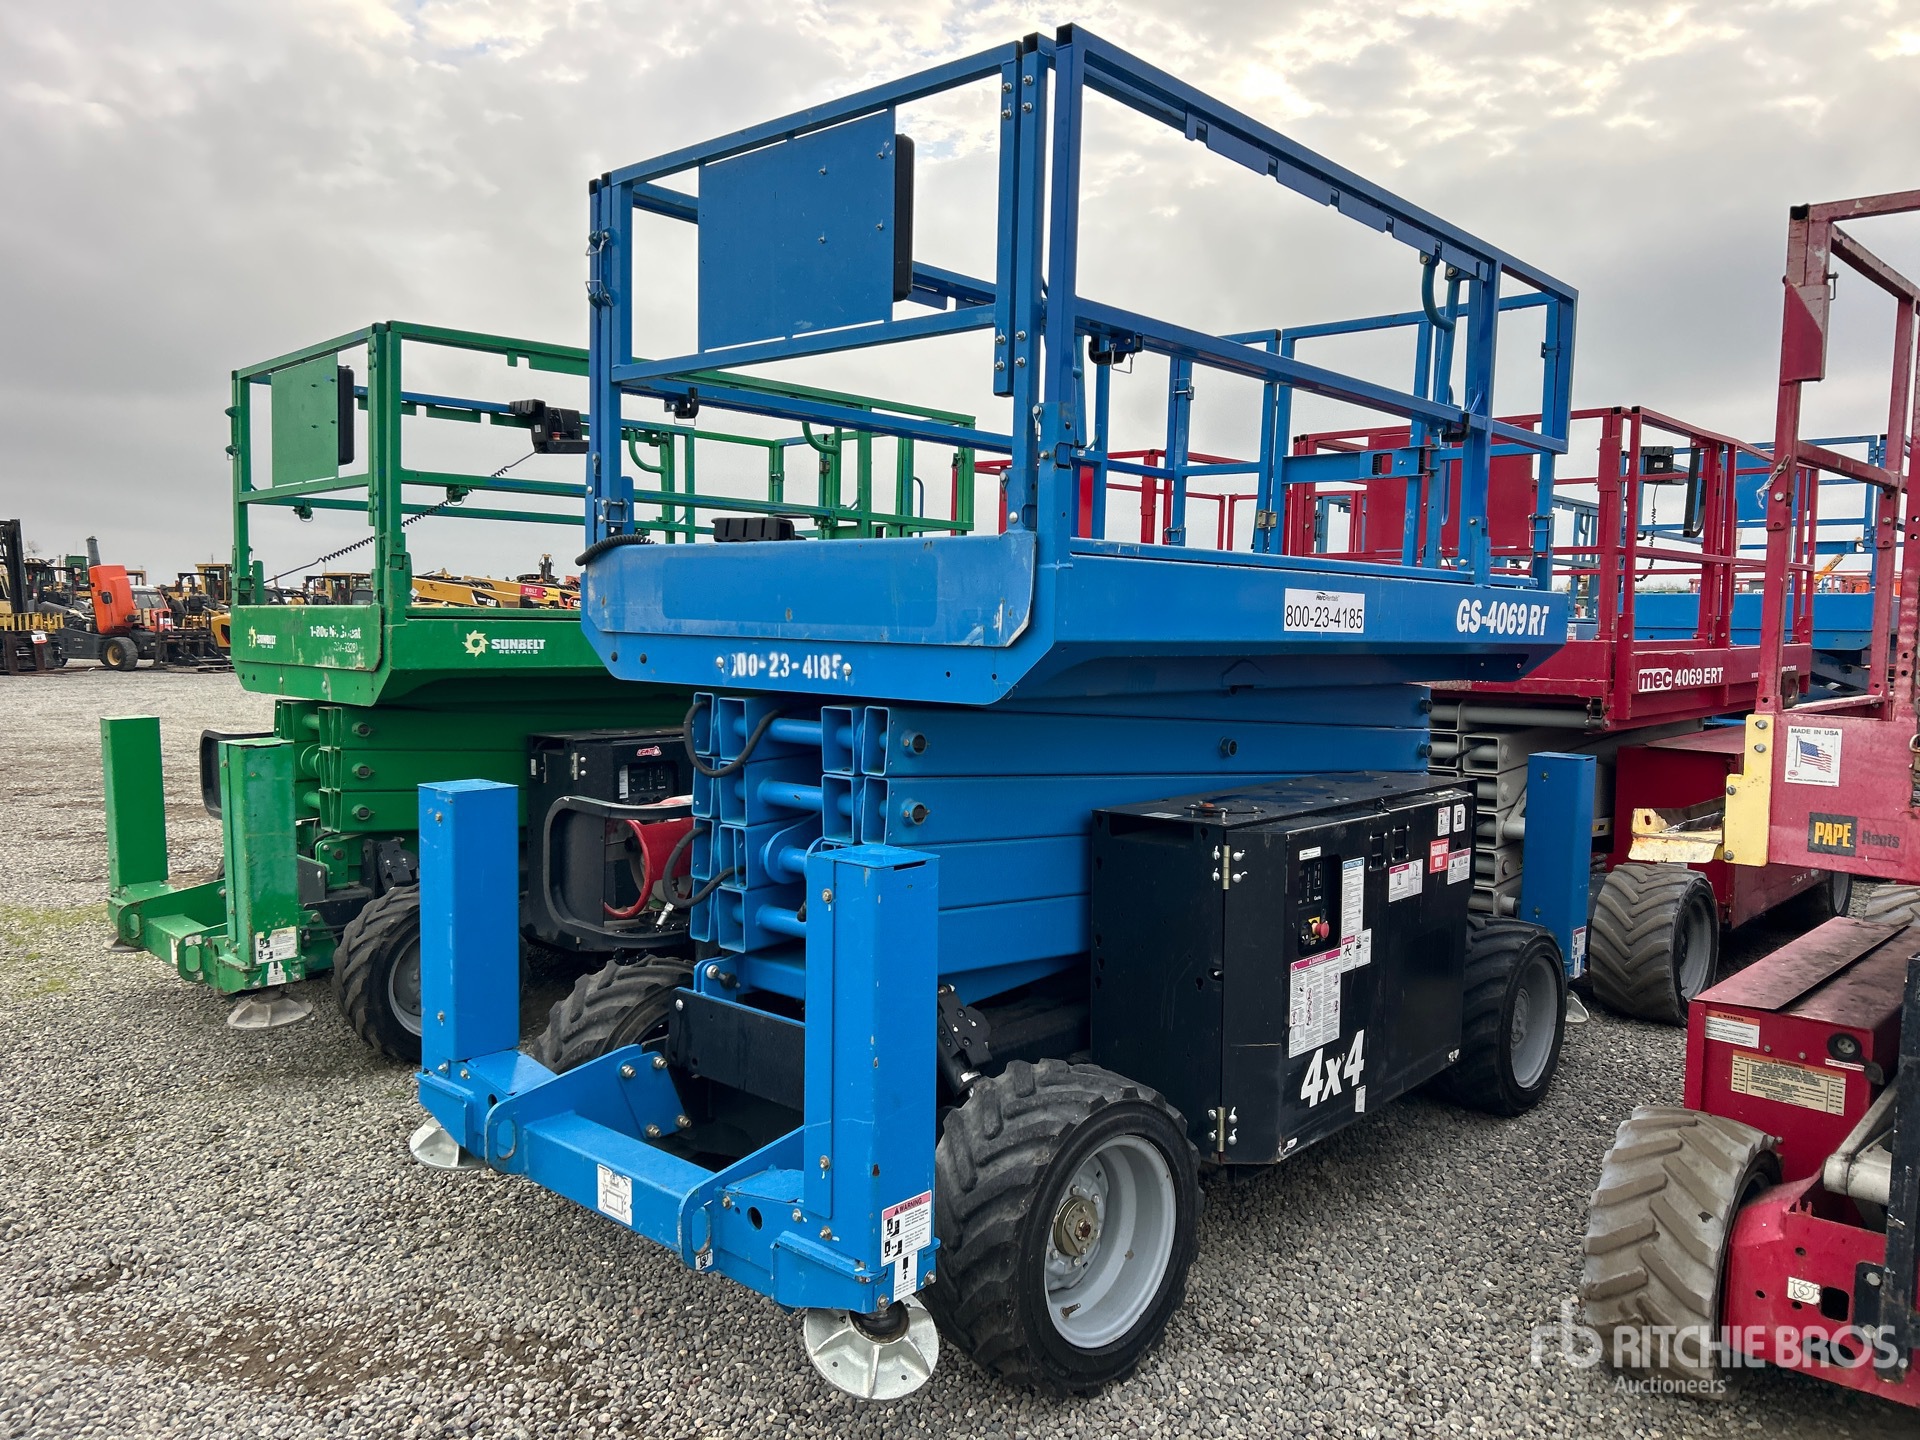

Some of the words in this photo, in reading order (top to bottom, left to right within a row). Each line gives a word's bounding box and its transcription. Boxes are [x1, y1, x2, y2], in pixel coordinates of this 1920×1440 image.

[486, 599, 497, 607] CAT
[1285, 605, 1363, 629] 800-23-4185
[1456, 598, 1528, 635] GS-4069
[491, 638, 546, 650] SUNBELT
[1638, 668, 1673, 692] mec
[1674, 669, 1703, 687] 4069
[1703, 667, 1724, 684] ERT
[1301, 1029, 1365, 1108] 4x4
[900, 1198, 922, 1212] WARNING
